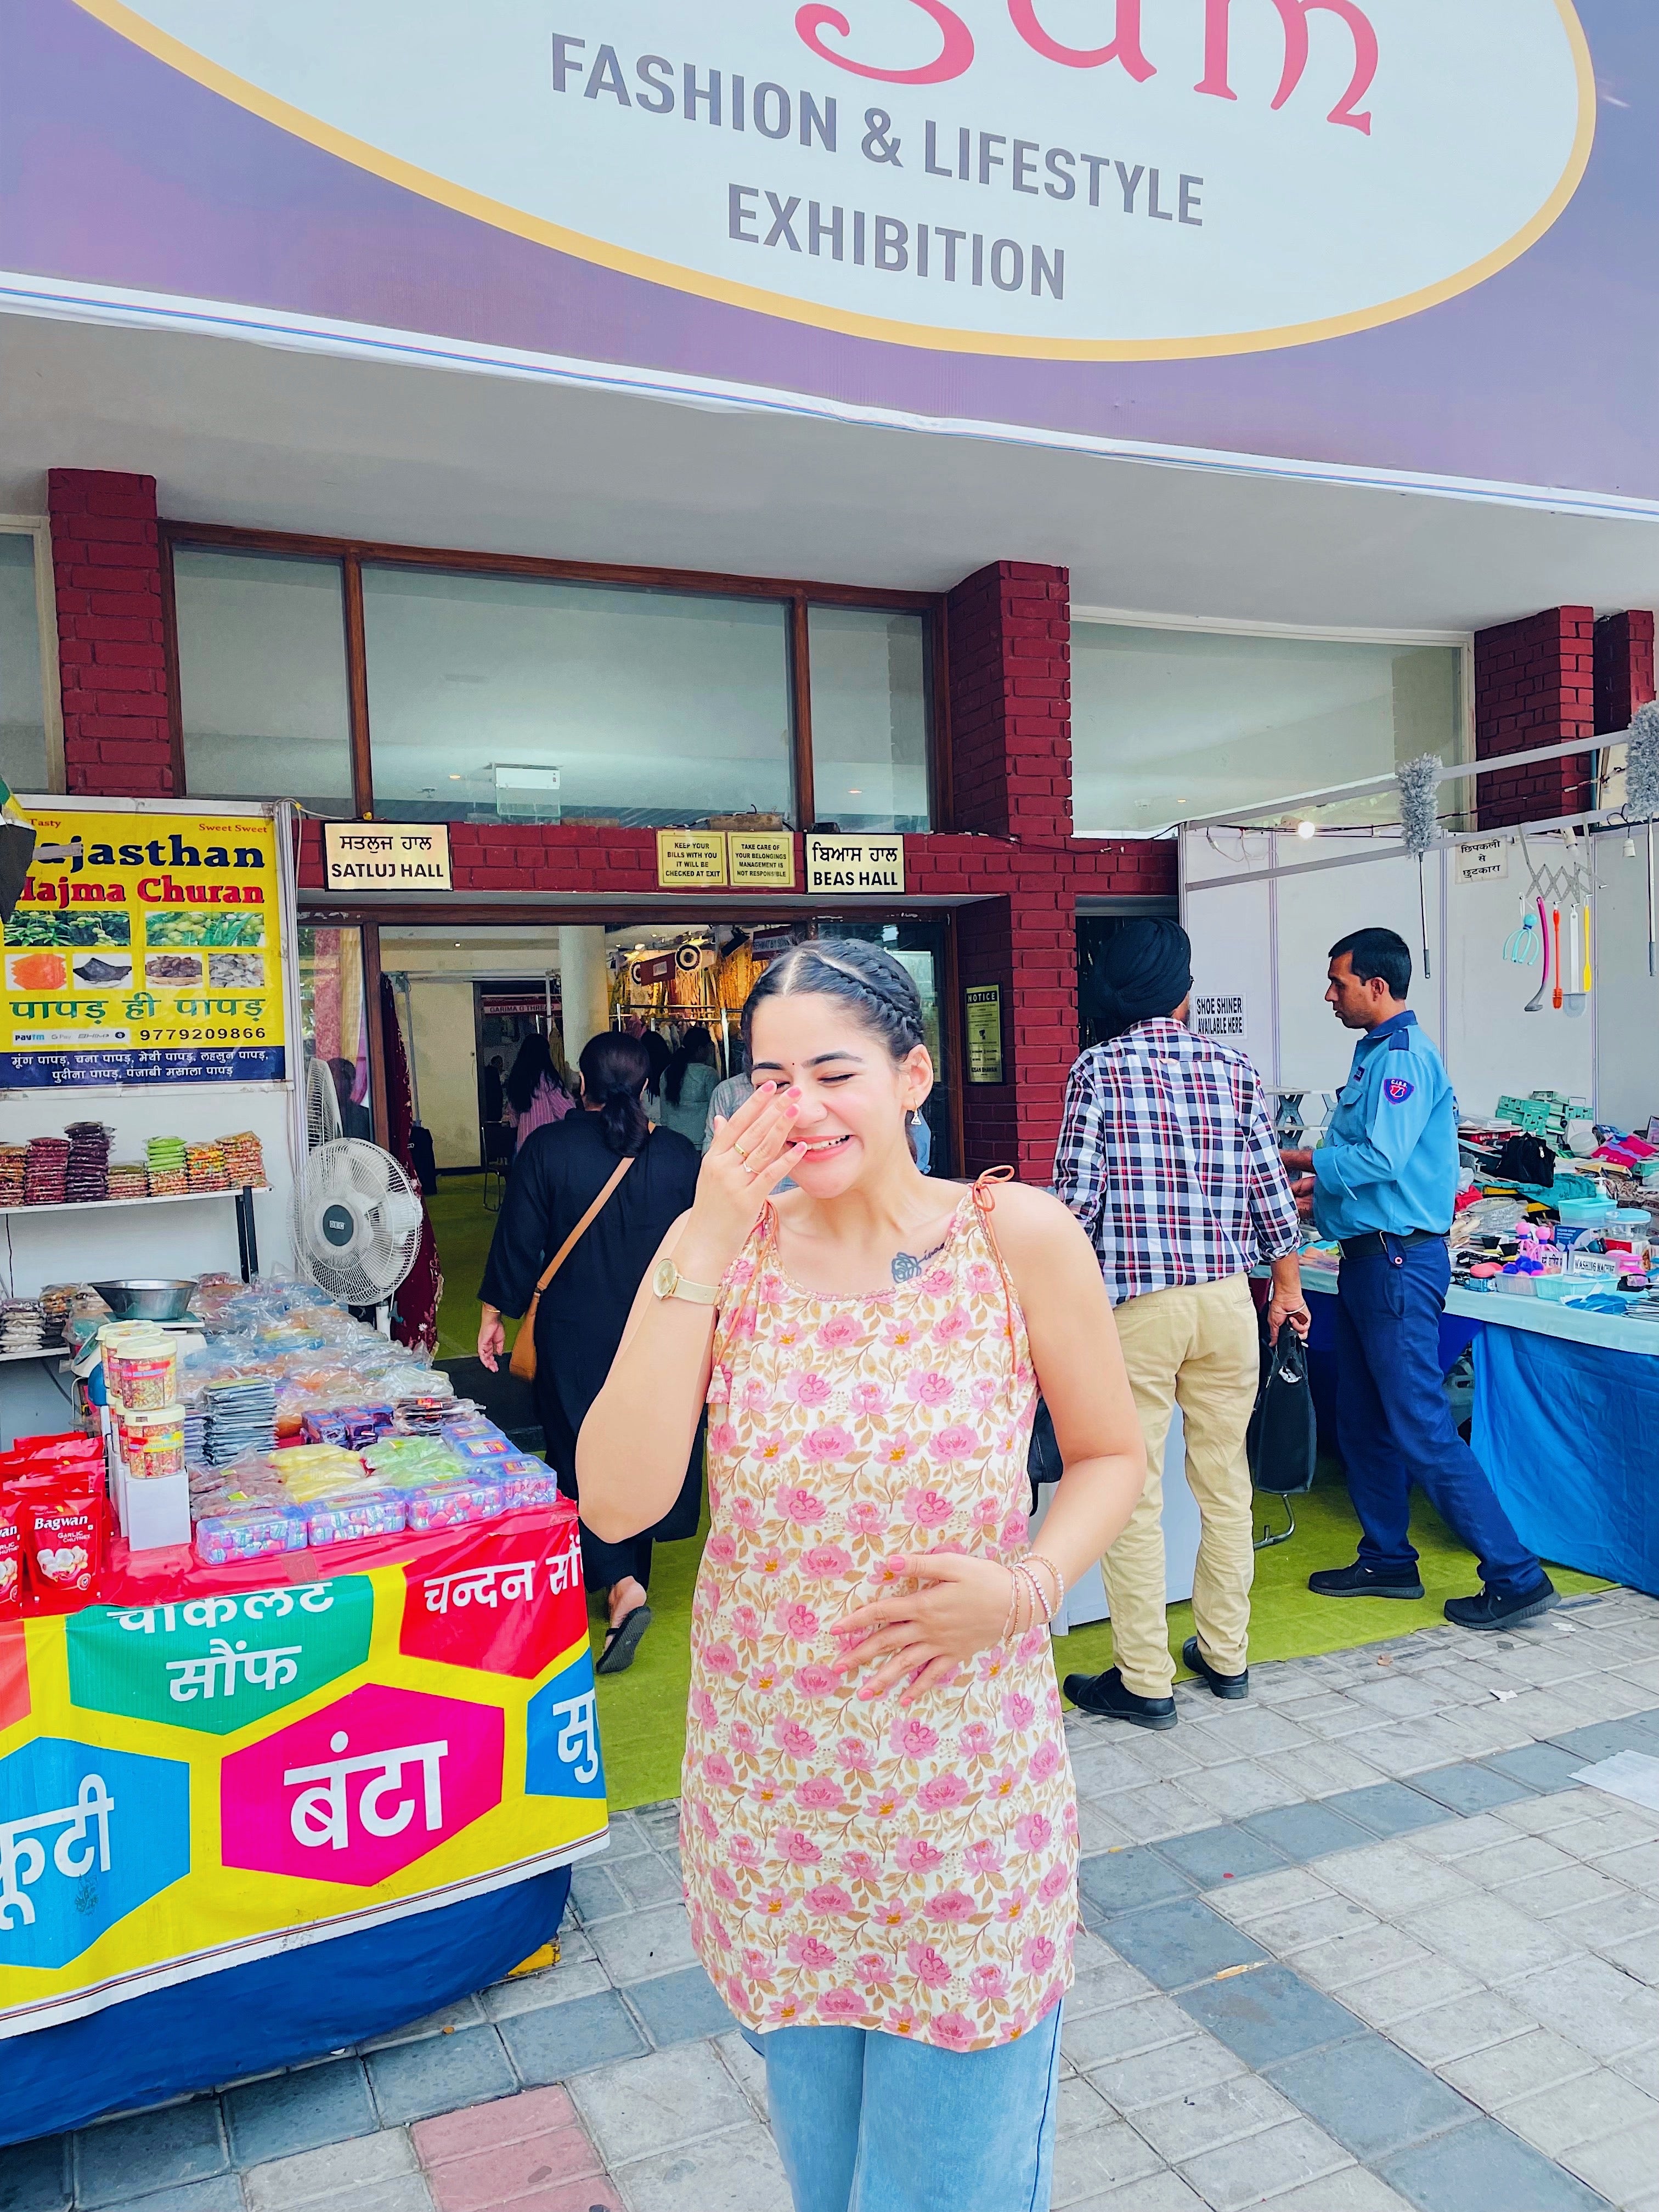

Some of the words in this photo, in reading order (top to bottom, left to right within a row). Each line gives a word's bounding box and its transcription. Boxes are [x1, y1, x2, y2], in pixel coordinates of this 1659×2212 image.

[552, 32, 838, 152] FASHION
[861, 107, 904, 167] &
[923, 119, 1204, 227] LIFESTYLE
[727, 183, 1065, 301] EXHIBITION
[30, 819, 61, 828] Tasty
[235, 825, 267, 833] Sweet
[340, 836, 393, 853] ਸਤਲੁਜ
[400, 837, 432, 850] ਹਾਲ
[812, 842, 862, 861] ਬਿਆਸ
[868, 848, 898, 861] ਹਾਲ
[1461, 839, 1500, 853] छिपकली
[37, 834, 265, 873] jasthan
[332, 864, 396, 877] SATLUJ
[401, 864, 444, 877] HALL
[814, 872, 855, 885] BEAS
[859, 872, 898, 885] HALL
[1463, 865, 1500, 878] छुटकारा
[137, 875, 265, 904] Churan
[968, 992, 995, 1002] NOTICE
[9, 1001, 109, 1024] पापड़
[122, 992, 161, 1020] ही
[174, 998, 266, 1022] पापड़
[1197, 998, 1215, 1014] SHOE
[1217, 997, 1242, 1014] SHINER
[1198, 1018, 1227, 1035] AVAILABLE
[1228, 1017, 1242, 1034] HERE
[140, 1028, 266, 1041] 9779209866
[74, 1054, 99, 1063] चना
[34, 1515, 88, 1531] Bagwan
[58, 1531, 83, 1539] GARLIC
[0, 1542, 15, 1551] RLIC
[424, 1560, 535, 1614] चन्दन
[545, 1534, 584, 1595] सौं
[166, 1638, 302, 1702] सौंफ
[284, 1730, 448, 1850] बंटा
